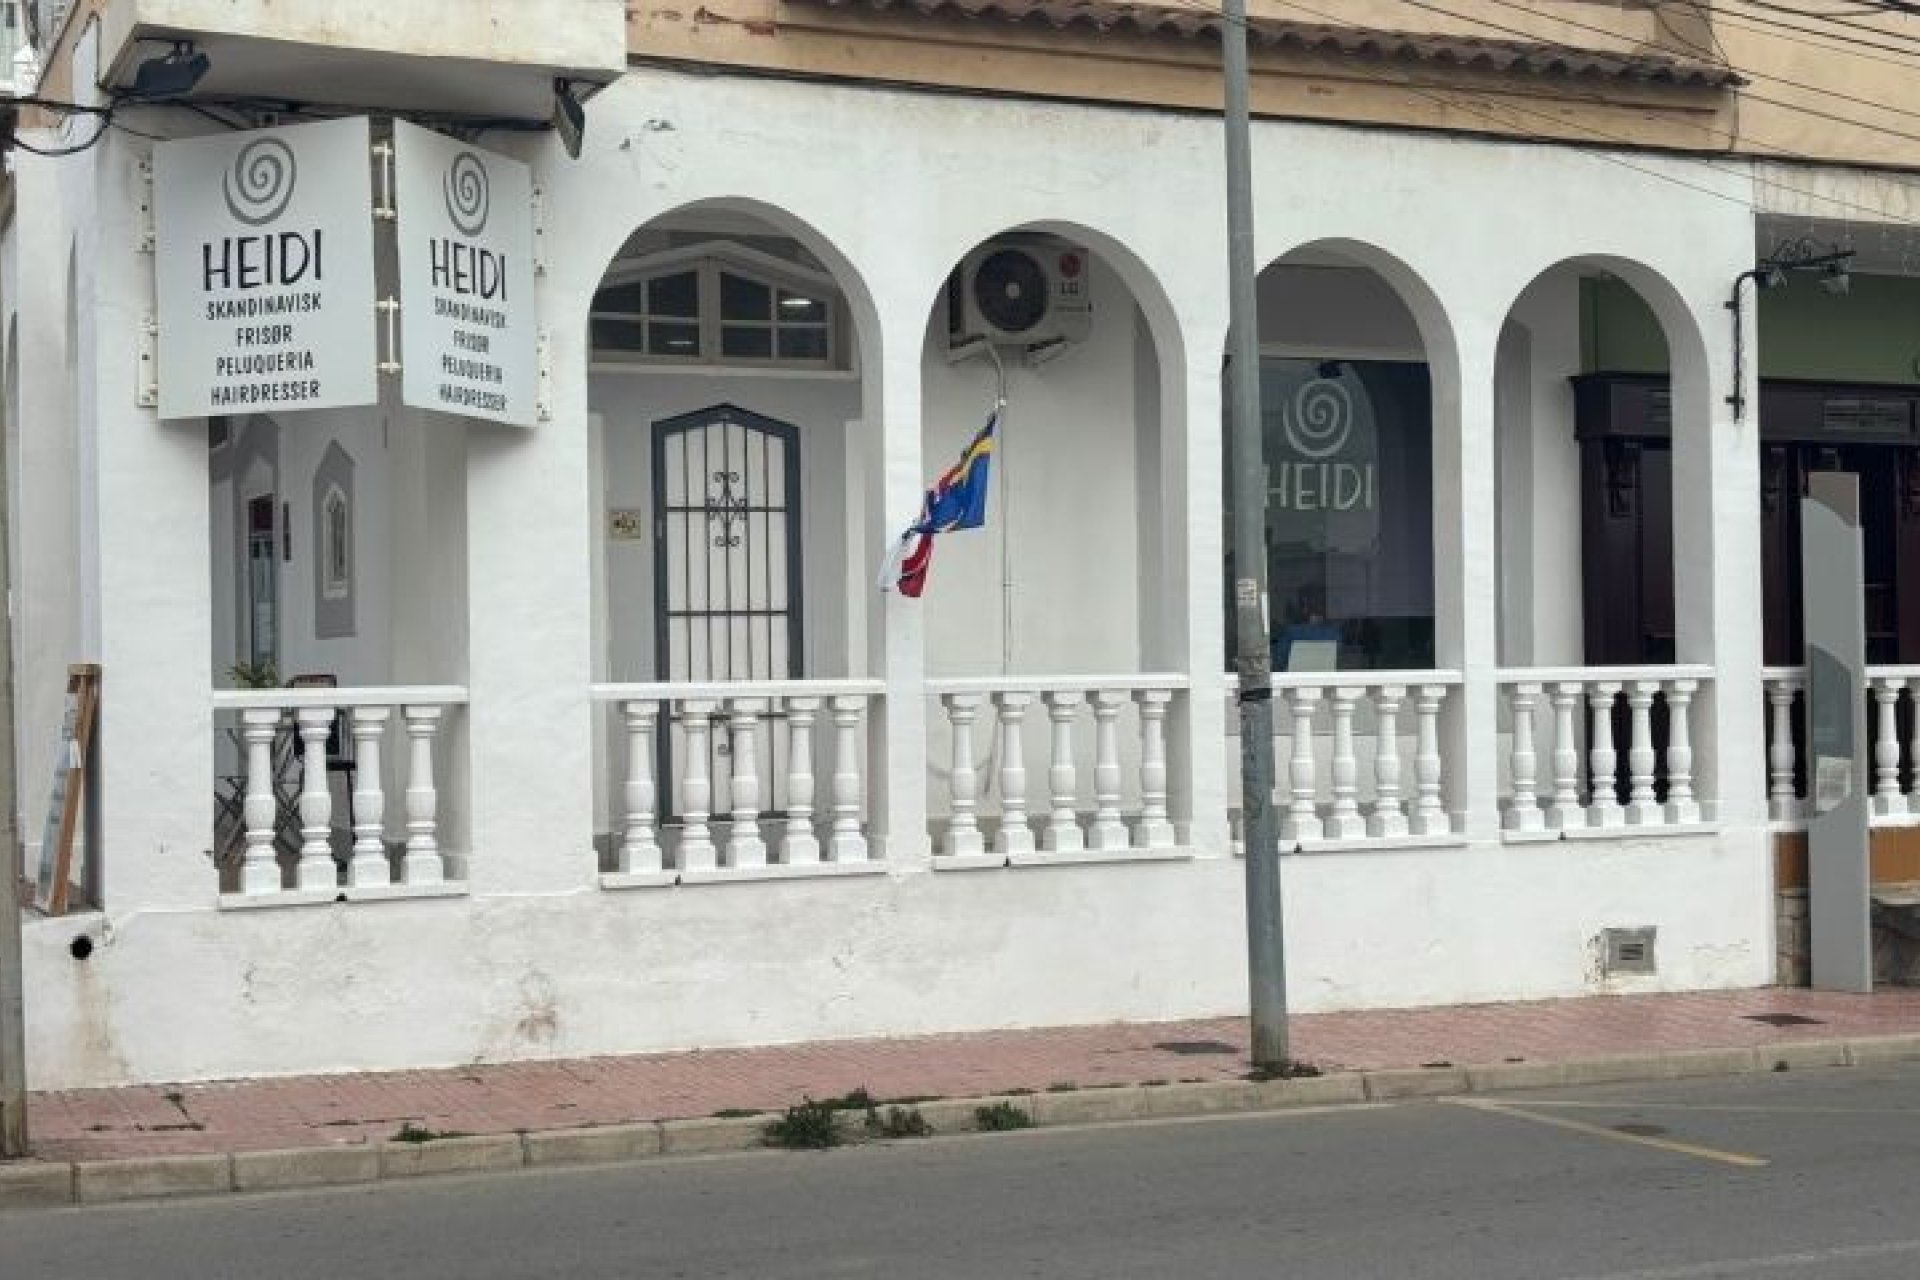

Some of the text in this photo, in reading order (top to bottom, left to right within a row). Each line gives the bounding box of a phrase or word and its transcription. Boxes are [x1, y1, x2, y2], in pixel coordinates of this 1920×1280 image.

[203, 229, 321, 291] HEIDI
[430, 237, 507, 301] HEIDI
[205, 293, 321, 320] SKANDINAVISK
[216, 351, 314, 376] PELUQUERIA
[210, 380, 321, 405] HAIRDRESSER
[1263, 462, 1373, 510] HEIDI
